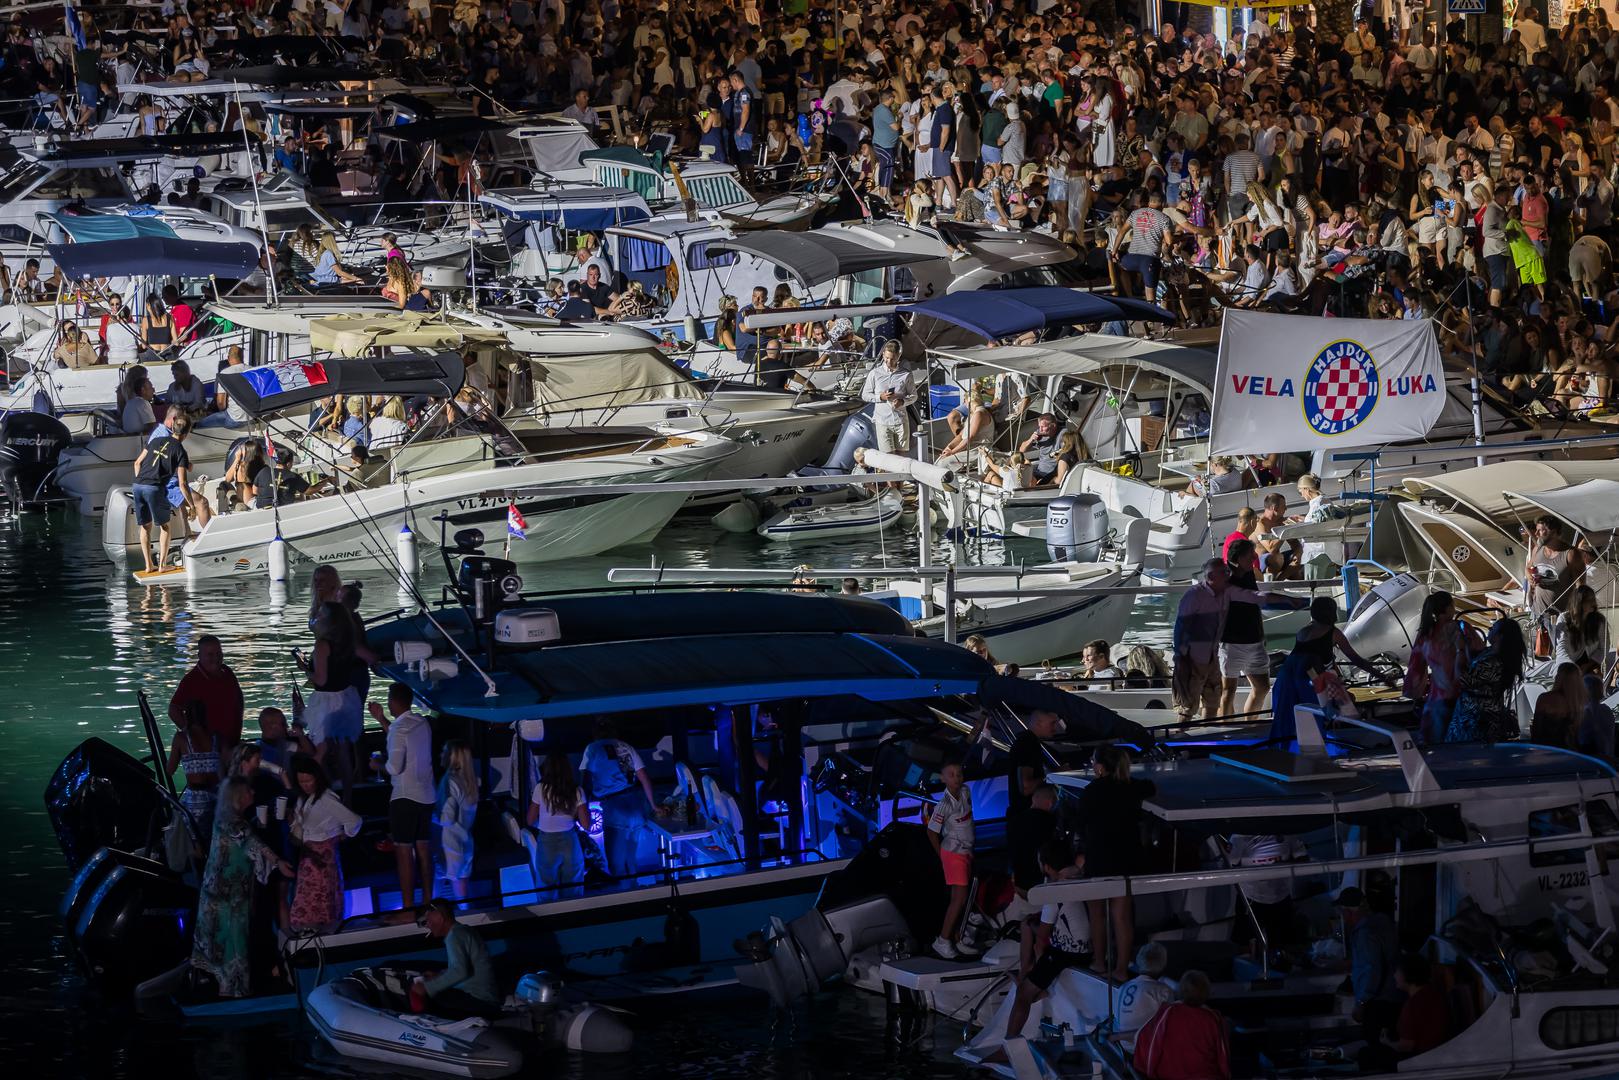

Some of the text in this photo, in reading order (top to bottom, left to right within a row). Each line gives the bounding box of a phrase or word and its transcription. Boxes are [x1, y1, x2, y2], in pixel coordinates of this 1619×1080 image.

[1313, 343, 1374, 375] HAJDUK
[1231, 373, 1437, 397] VELA LUKA
[1310, 412, 1360, 434] SPLIT
[1049, 517, 1069, 525] 150
[318, 550, 362, 562] MARINE
